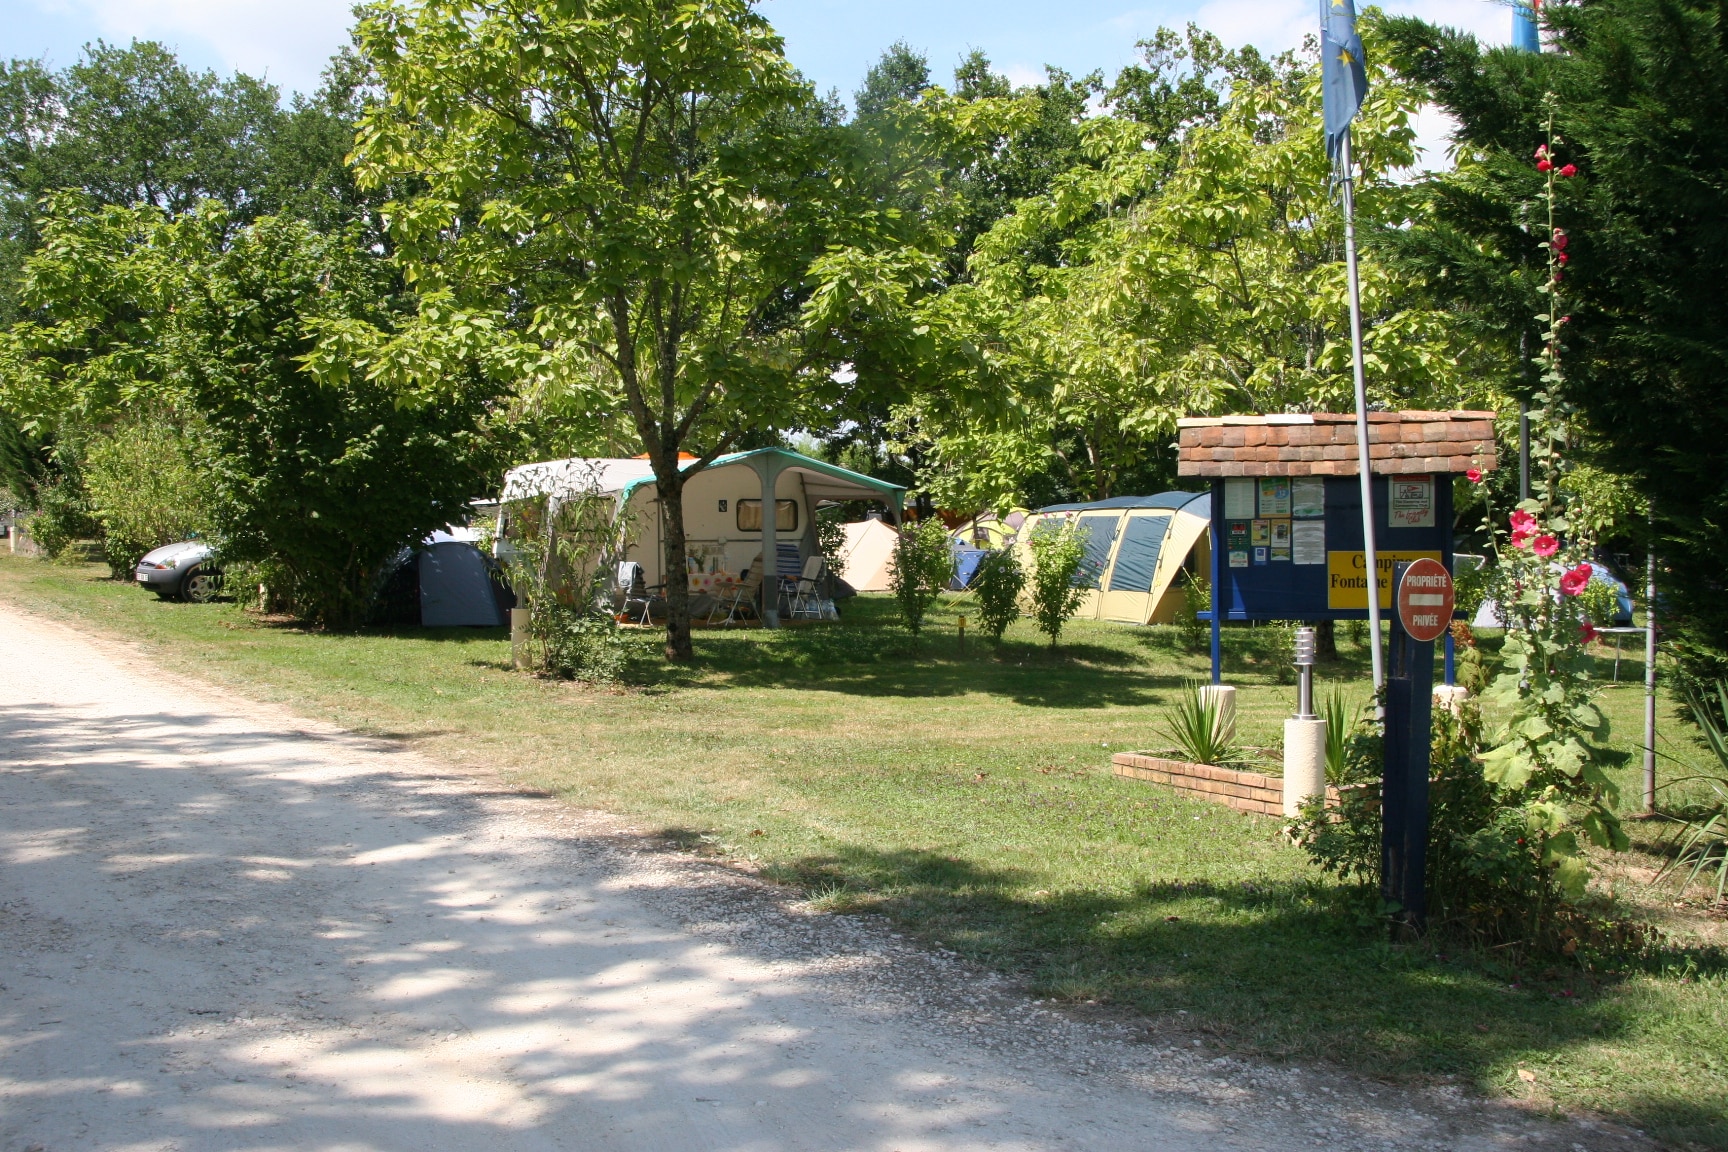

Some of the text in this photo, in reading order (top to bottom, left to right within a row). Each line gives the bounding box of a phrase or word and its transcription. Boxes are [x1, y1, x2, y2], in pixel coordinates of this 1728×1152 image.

[1352, 554, 1413, 572] Camp
[1330, 574, 1388, 589] Fontae
[1406, 573, 1447, 588] PROPRIÉTÉ
[1412, 612, 1439, 627] PRIVÉE
